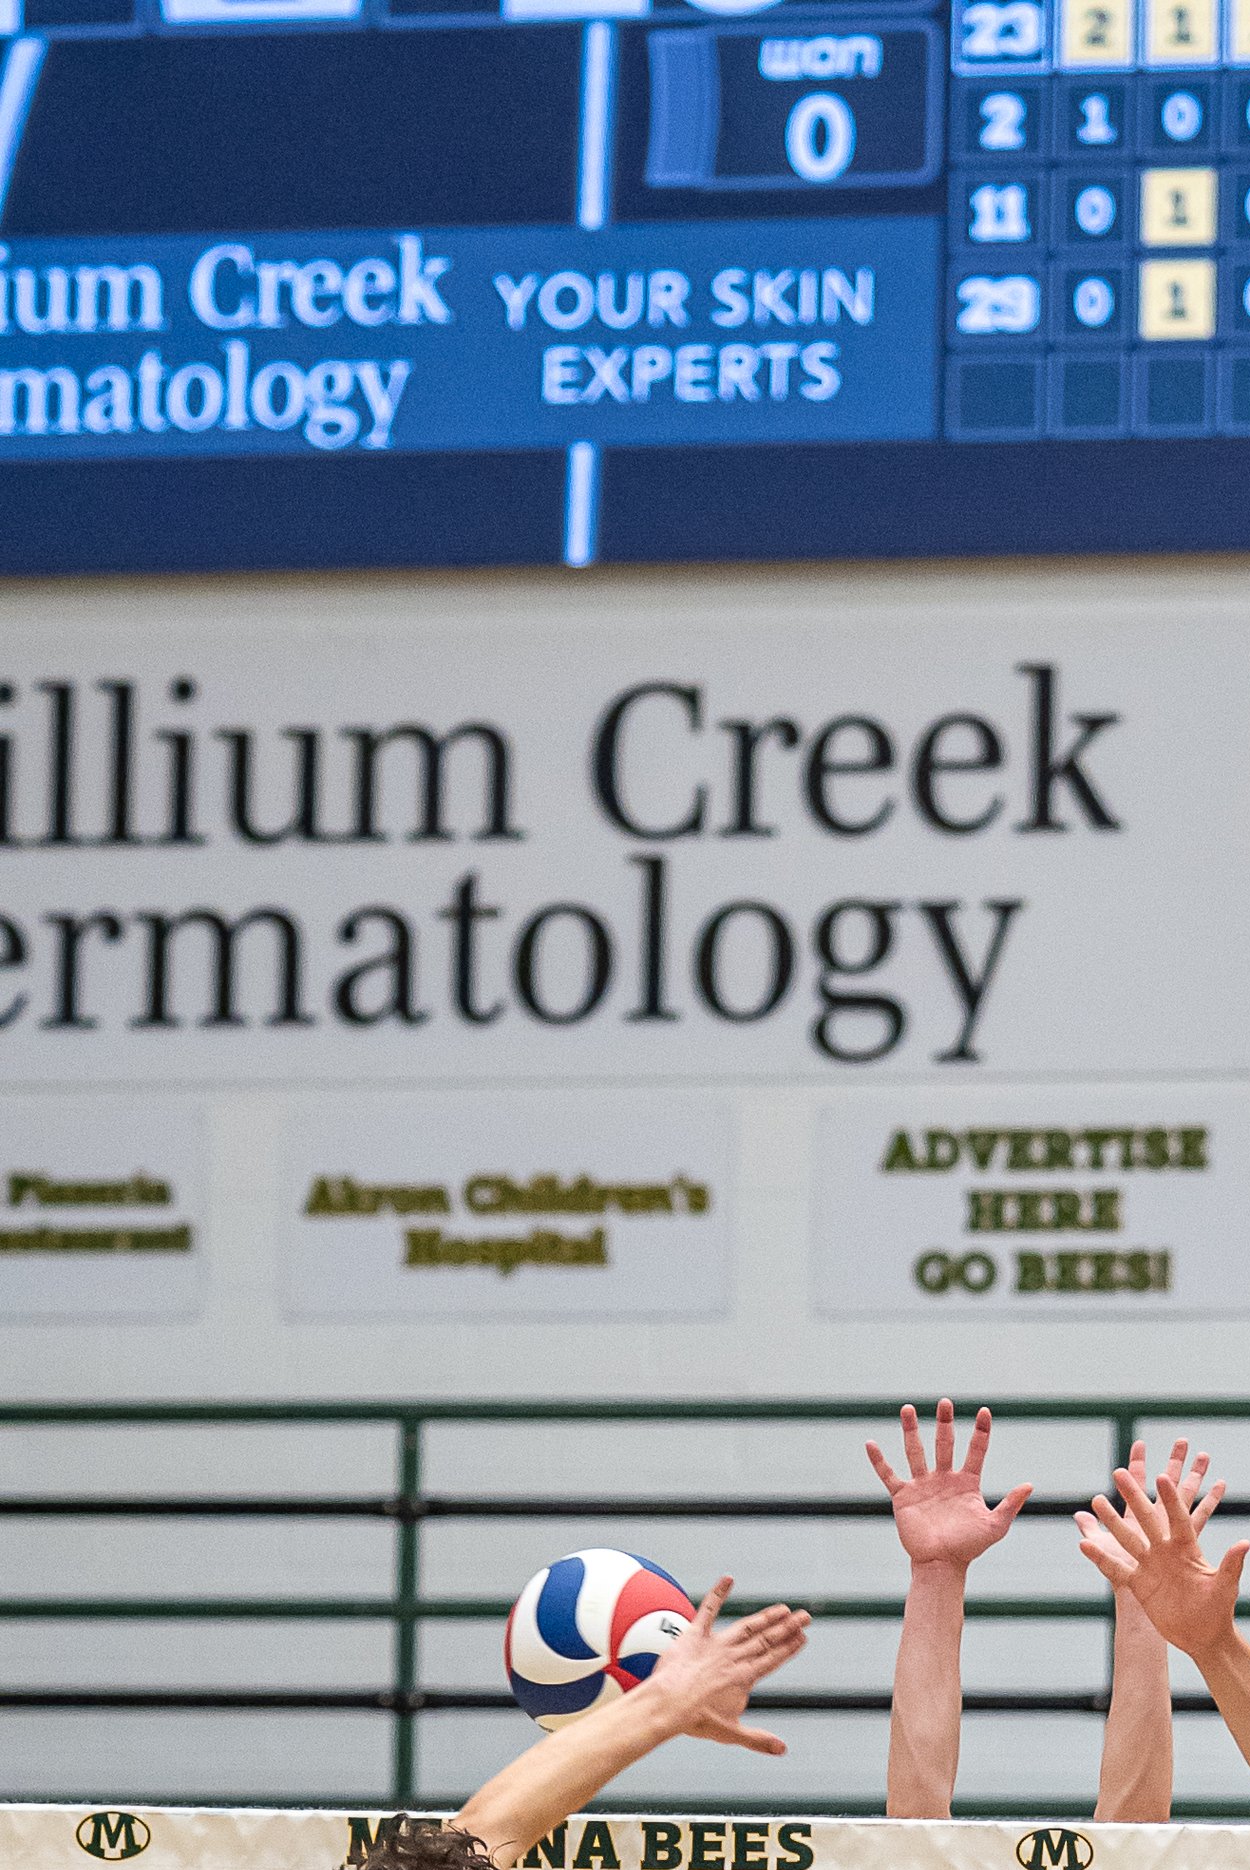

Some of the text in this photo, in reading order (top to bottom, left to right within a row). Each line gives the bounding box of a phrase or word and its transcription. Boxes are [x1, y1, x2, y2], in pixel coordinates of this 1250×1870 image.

[1086, 8, 1114, 46] 2
[1170, 4, 1192, 44] 1
[760, 35, 880, 79] won
[787, 94, 852, 181] 0
[980, 93, 1024, 149] 2
[1082, 99, 1110, 140] 1
[1163, 94, 1200, 139] 0
[970, 185, 1028, 242] 11
[1076, 187, 1113, 233] 0
[1168, 188, 1190, 213] 1
[190, 234, 448, 328] Creek
[495, 270, 688, 330] YOUR
[712, 268, 873, 327] SKIN
[1074, 279, 1111, 325] 0
[1167, 280, 1191, 308] 1
[0, 338, 840, 450] matology EXPERTS
[590, 661, 1124, 841] Creek
[882, 1127, 1208, 1172] ADVERTISE
[968, 1189, 1120, 1233] HERE
[915, 1250, 1170, 1294] GO BEES!
